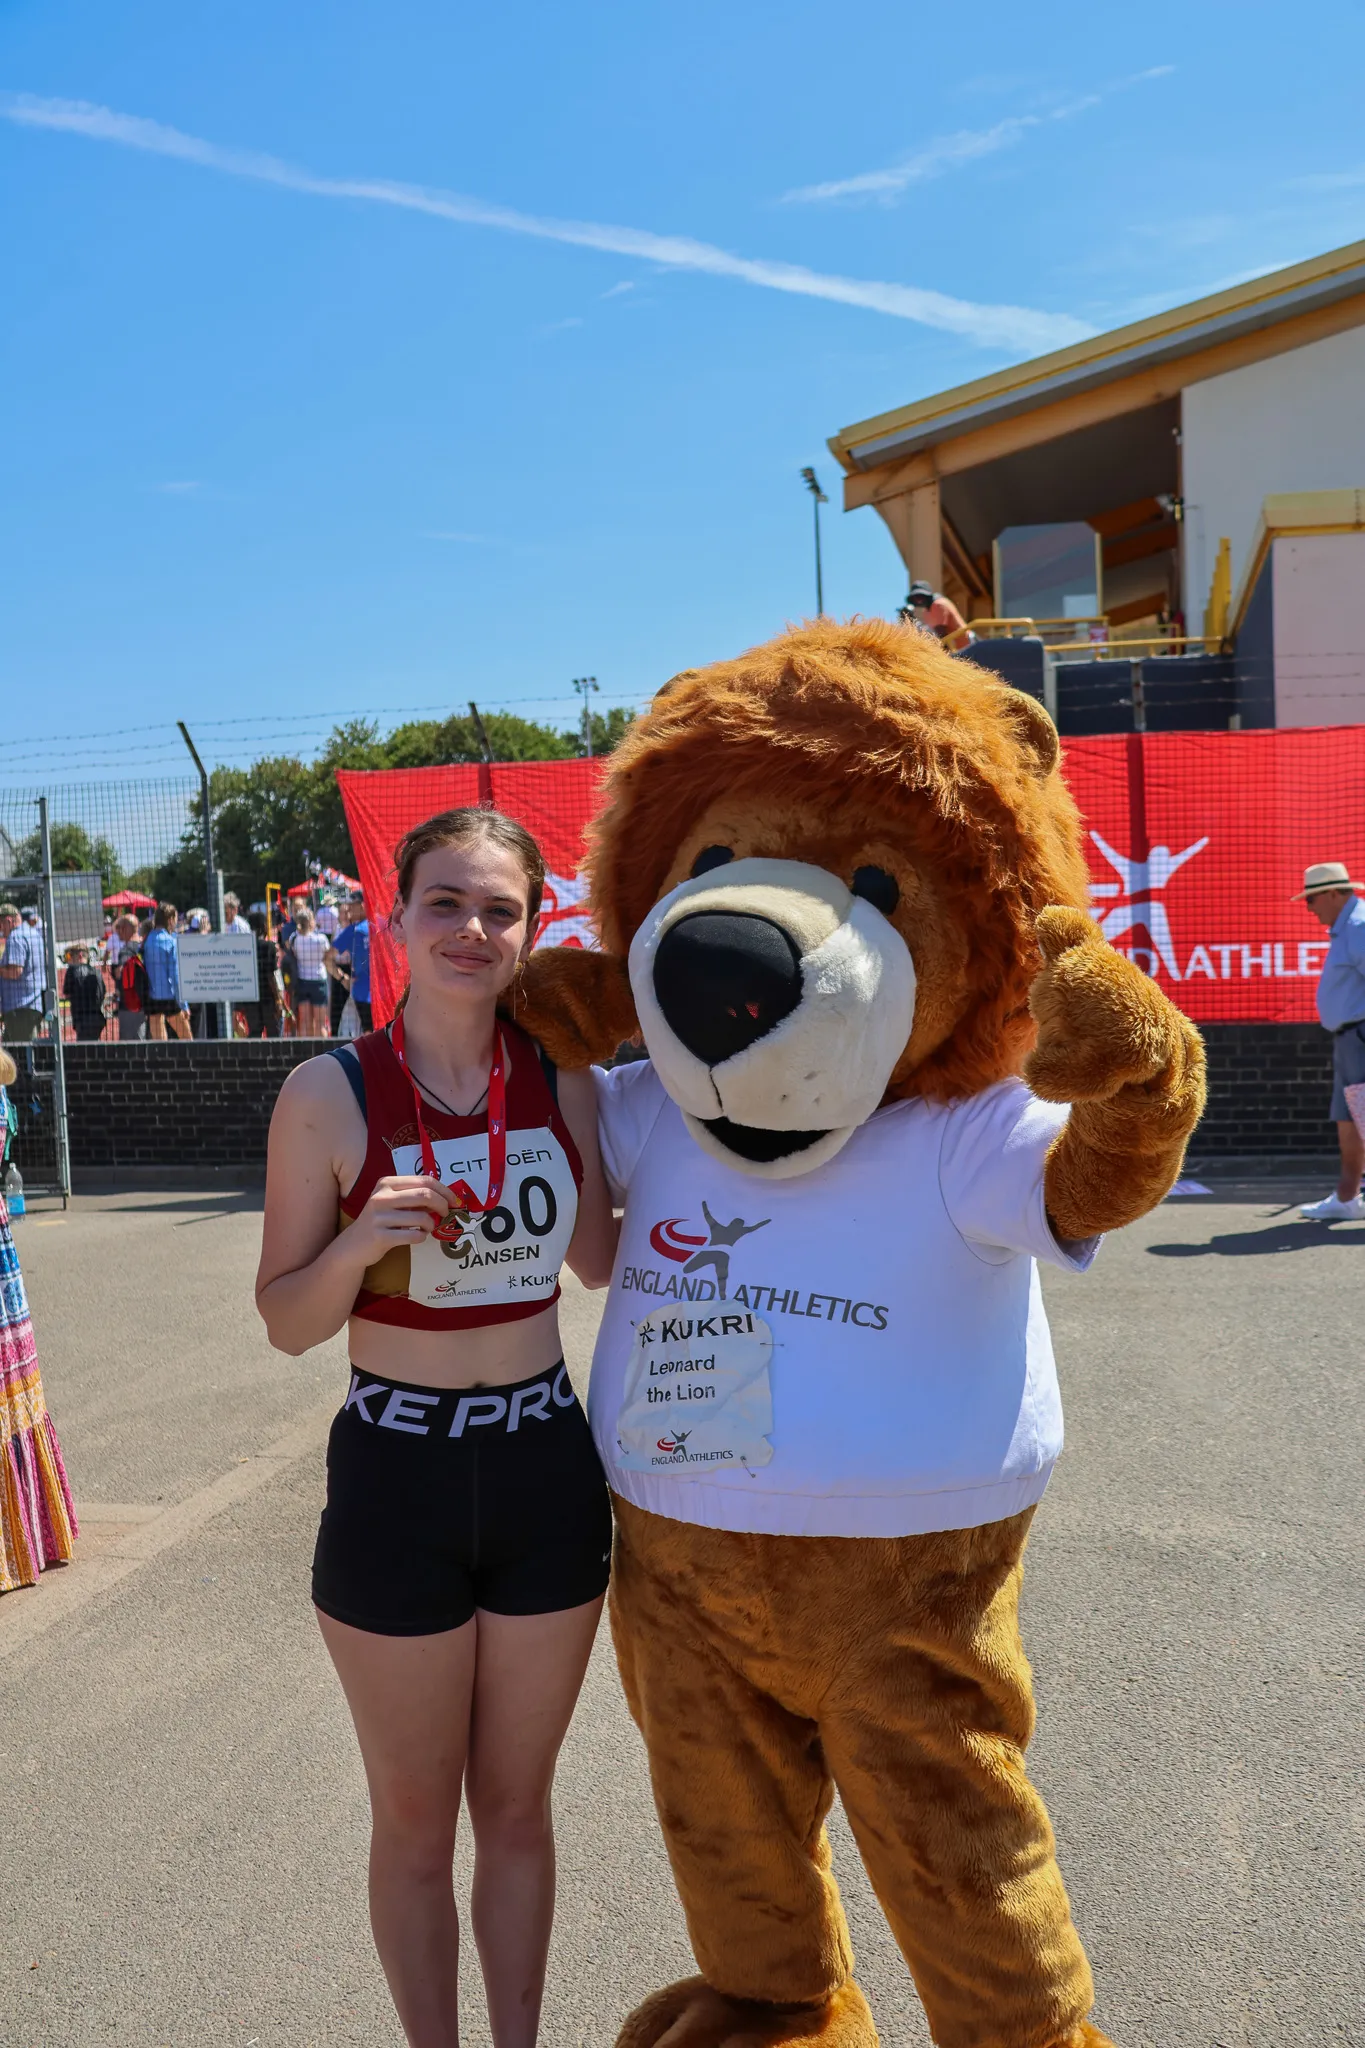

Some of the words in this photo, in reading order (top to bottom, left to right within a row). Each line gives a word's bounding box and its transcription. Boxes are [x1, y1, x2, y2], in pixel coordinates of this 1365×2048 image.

[181, 950, 211, 958] Important
[1185, 942, 1330, 979] ATHLE
[450, 1149, 552, 1174] CITOËN
[452, 1176, 557, 1243] 60
[459, 1244, 540, 1270] JANSEN
[427, 1292, 454, 1300] ENGLAND
[457, 1288, 486, 1296] ATHLETICS
[622, 1266, 717, 1301] ENGLAND
[733, 1284, 890, 1331] ATHLETICS
[661, 1313, 756, 1343] KUKRI
[650, 1355, 716, 1376] Leonard
[647, 1388, 672, 1403] the
[676, 1384, 716, 1401] Lion
[651, 1454, 684, 1466] ENGLAND
[689, 1450, 734, 1461] ATHLETICS
